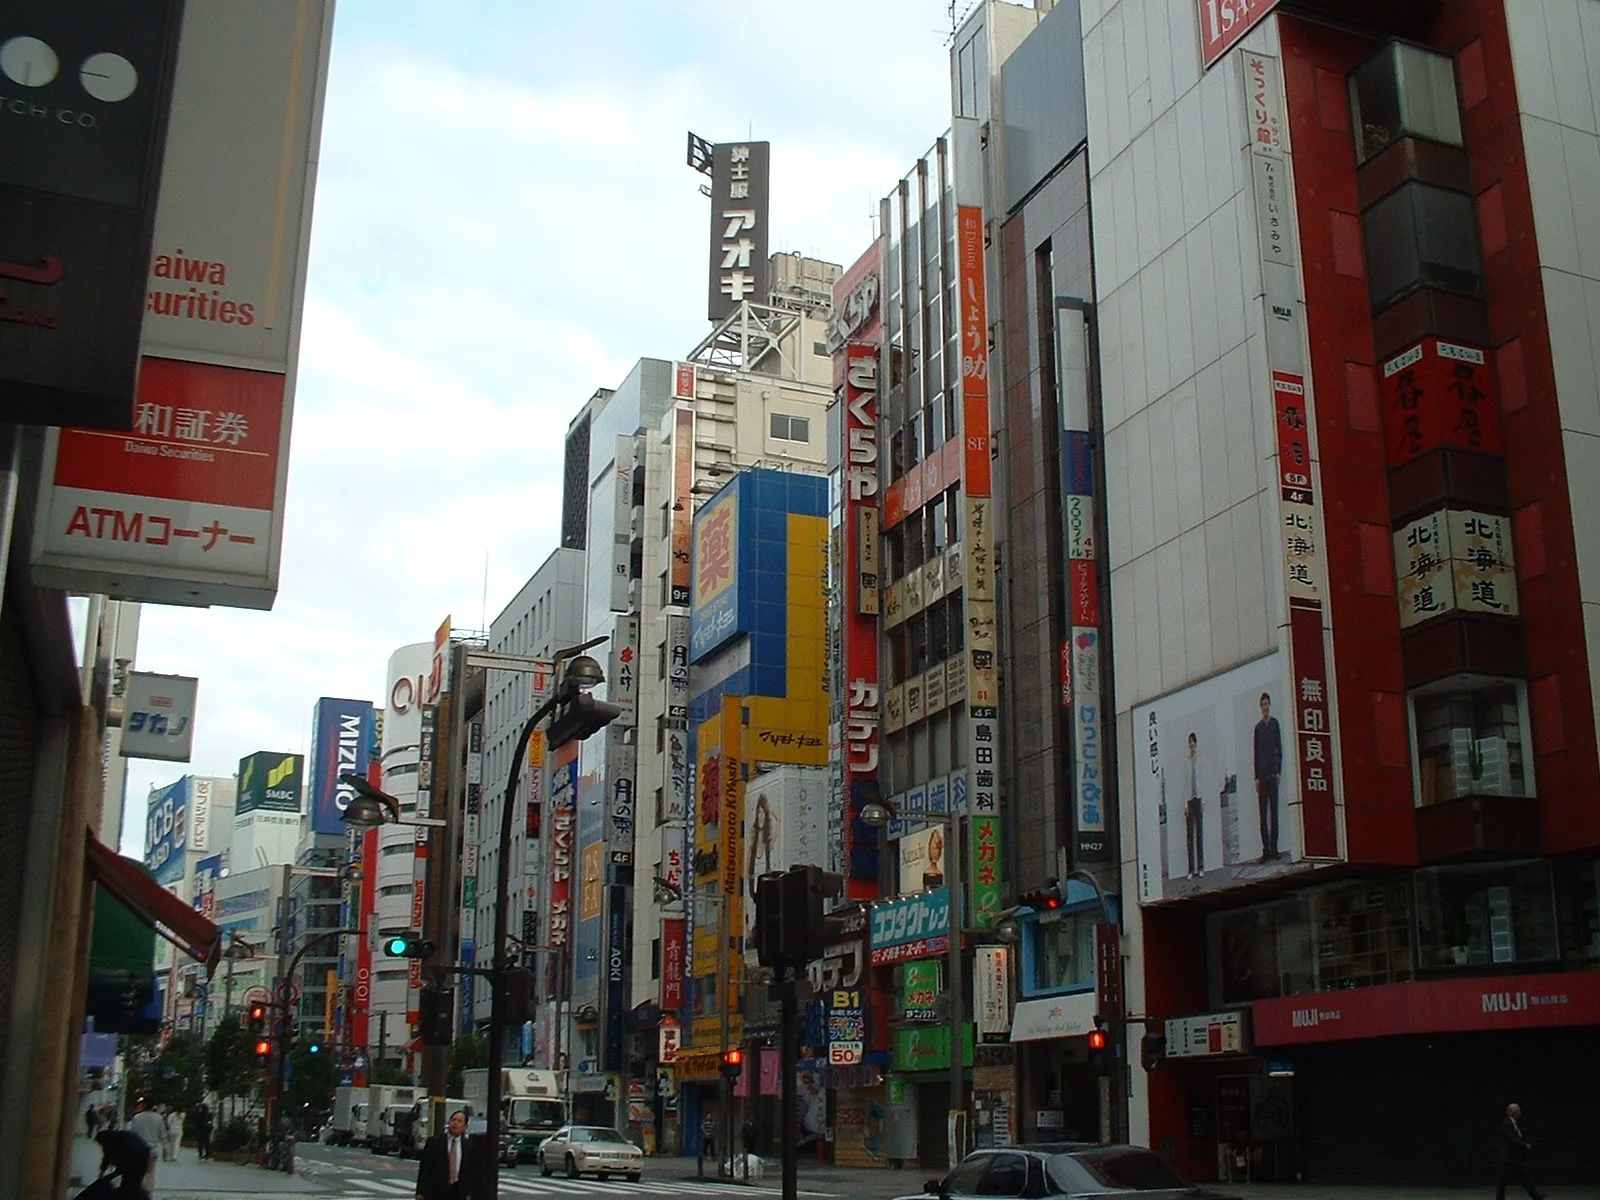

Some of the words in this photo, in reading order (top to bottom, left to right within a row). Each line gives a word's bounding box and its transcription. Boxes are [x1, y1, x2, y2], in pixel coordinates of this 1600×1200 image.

[720, 209, 755, 301] アオキ
[1272, 305, 1292, 317] MUJI
[847, 355, 878, 501] さくらや
[125, 441, 158, 457] Daiwa
[160, 445, 215, 463] Securities
[968, 437, 986, 451] 8F
[1290, 491, 1304, 501] 4F
[66, 506, 255, 551] ATMコーナー
[1286, 514, 1313, 586] 北海道
[1464, 518, 1502, 609] 北海道
[1407, 526, 1439, 614] 北海道
[673, 589, 688, 600] 9F
[671, 706, 687, 717] 4F
[973, 708, 992, 718] 4F
[1301, 677, 1327, 791] 無印良品
[975, 723, 995, 811] 島田歯科
[265, 789, 294, 800] SMBC
[146, 797, 174, 855] JCB
[554, 816, 572, 883] さくらや
[613, 852, 629, 864] 4F
[724, 812, 737, 895] Matsumoto
[610, 947, 622, 982] AOKI
[665, 939, 681, 1000] 青龍門
[833, 990, 859, 1008] B1
[1482, 992, 1529, 1013] MUJI
[1531, 995, 1569, 1005] 無印良品
[1292, 1008, 1319, 1028] MUJI
